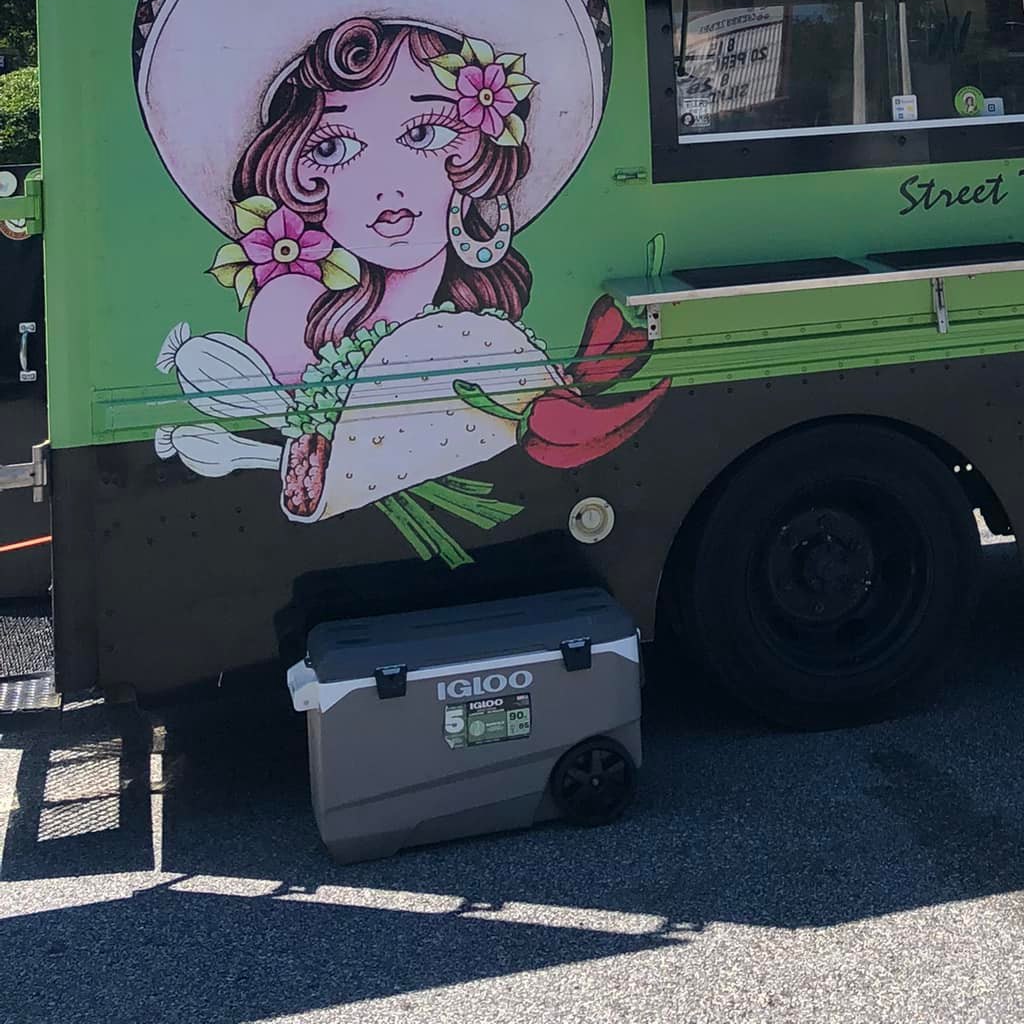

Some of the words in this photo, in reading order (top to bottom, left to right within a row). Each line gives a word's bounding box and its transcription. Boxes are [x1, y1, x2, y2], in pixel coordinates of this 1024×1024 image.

[900, 174, 1008, 216] Street
[437, 670, 533, 701] IGLOO
[469, 698, 504, 710] IGLOO
[445, 710, 464, 734] 5
